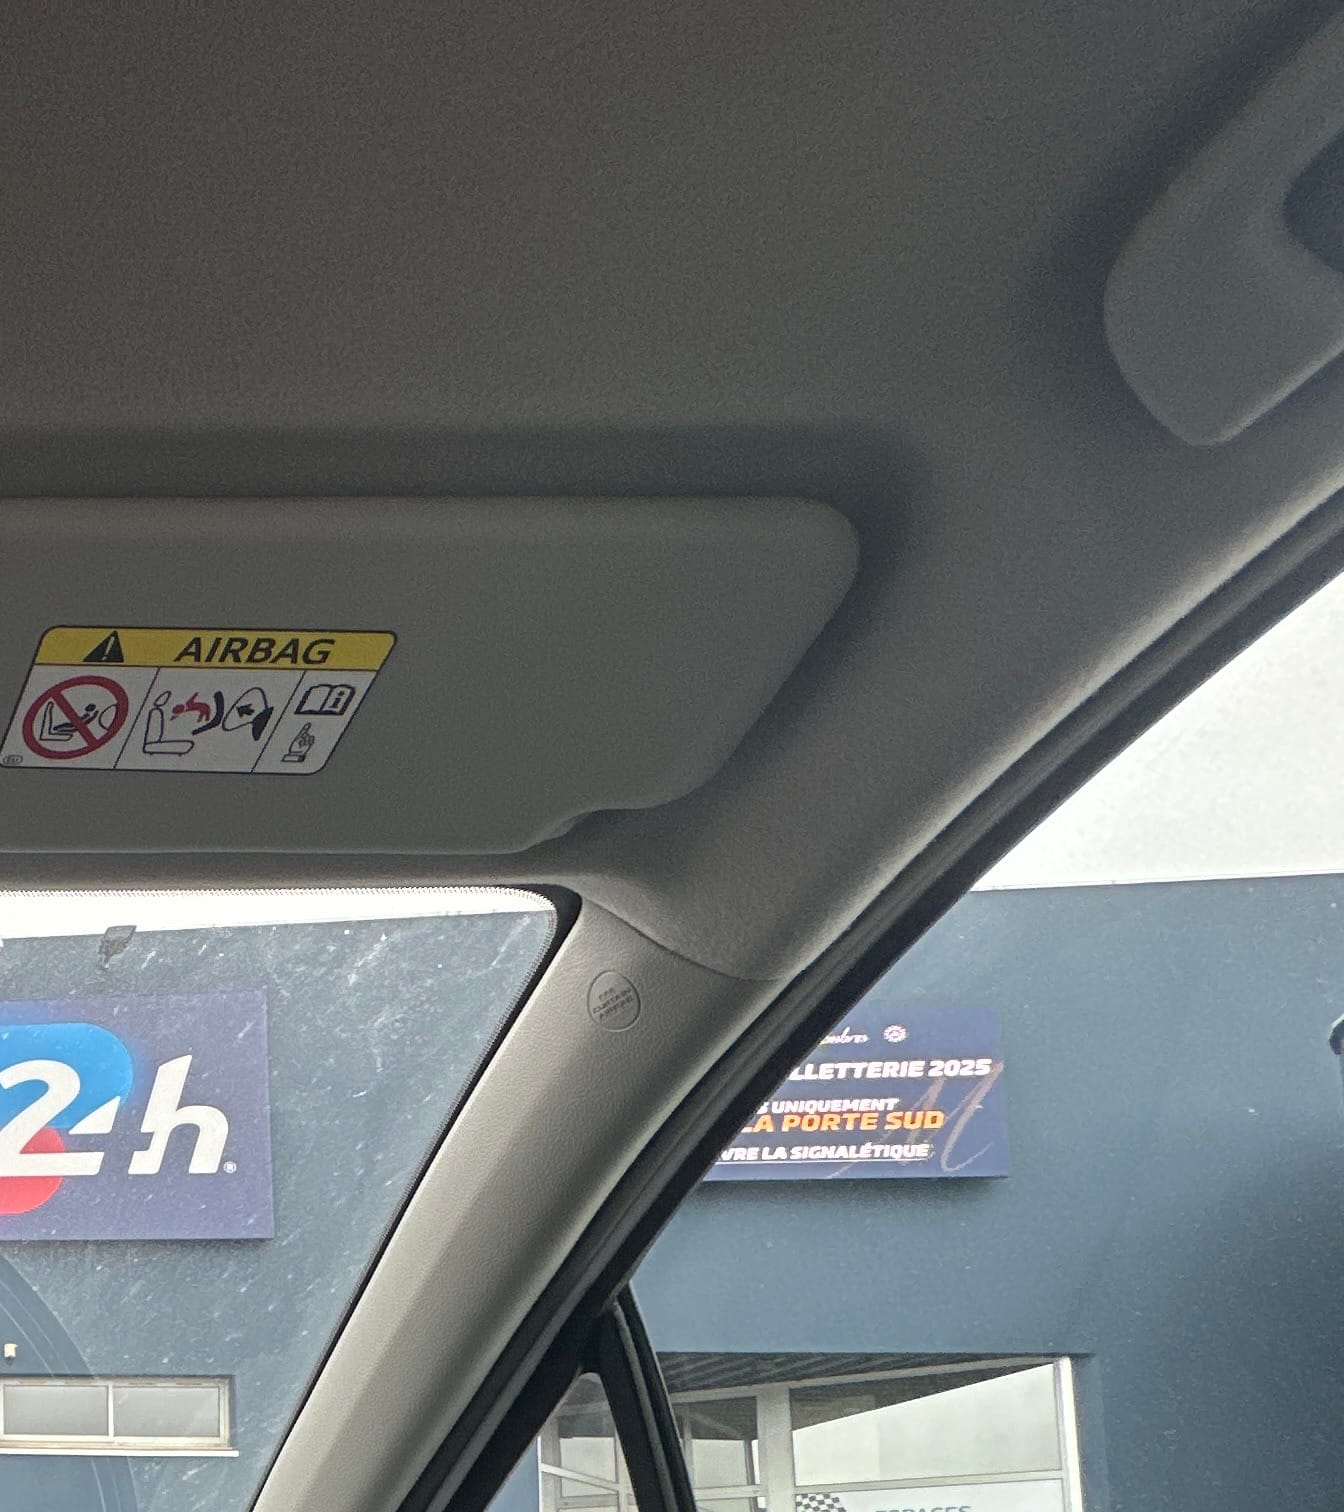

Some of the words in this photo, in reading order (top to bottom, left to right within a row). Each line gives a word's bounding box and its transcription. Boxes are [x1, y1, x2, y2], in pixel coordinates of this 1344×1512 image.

[173, 636, 336, 666] AIRBAG
[789, 1061, 924, 1081] LLETTERIE
[928, 1058, 993, 1077] 2025
[772, 1098, 900, 1114] UNIQUEMENT
[782, 1113, 878, 1132] PORTE
[884, 1110, 945, 1130] SUD
[721, 1147, 759, 1161] VRE
[762, 1146, 787, 1160] LA
[790, 1142, 930, 1160] SIGNALÉTIQUE
